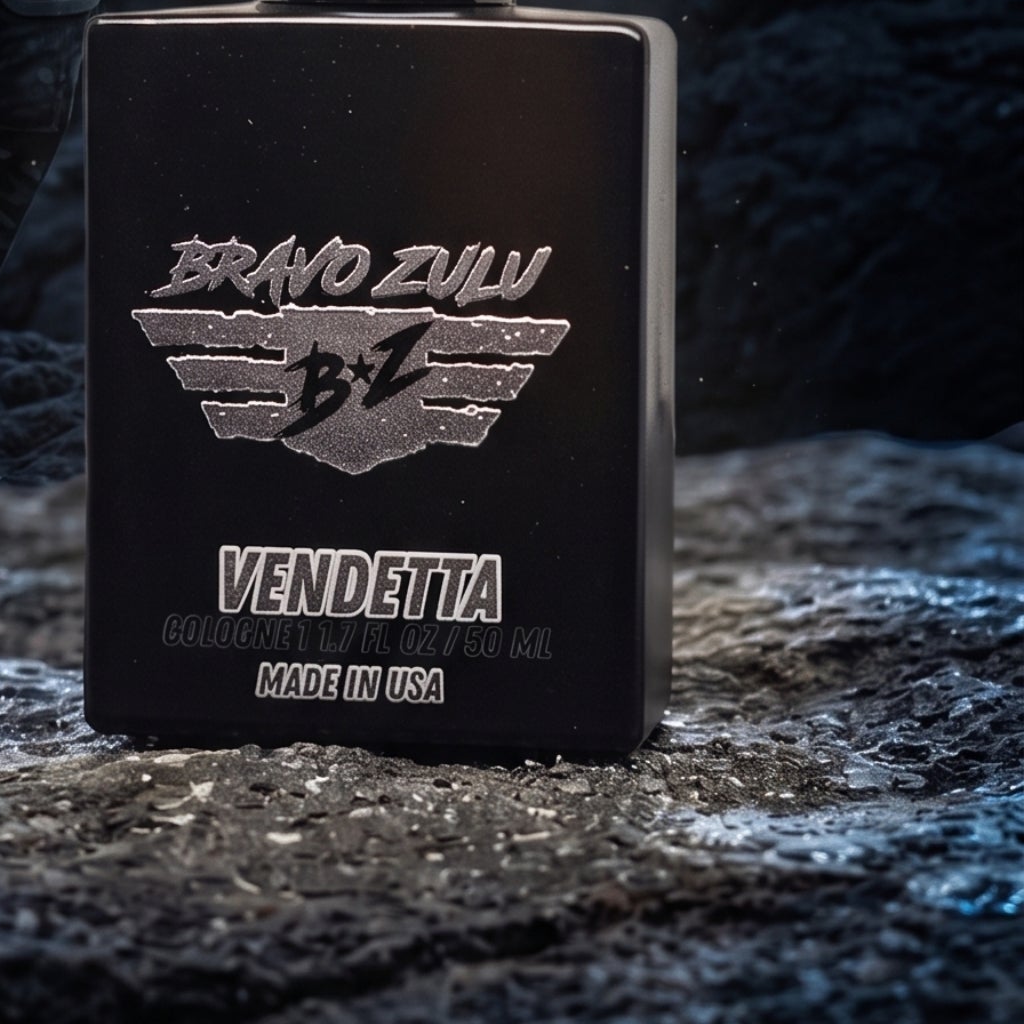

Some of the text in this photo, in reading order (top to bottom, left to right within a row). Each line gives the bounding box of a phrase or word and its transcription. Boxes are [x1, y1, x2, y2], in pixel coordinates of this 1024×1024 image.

[147, 234, 553, 308] BRAVO ZULU
[218, 545, 503, 623] VENDETTA
[318, 620, 358, 653] 1.7
[361, 622, 391, 655] FL
[399, 623, 440, 657] OZ
[463, 626, 503, 659] 50
[509, 626, 553, 660] ML
[255, 661, 445, 705] MADE IN USA
